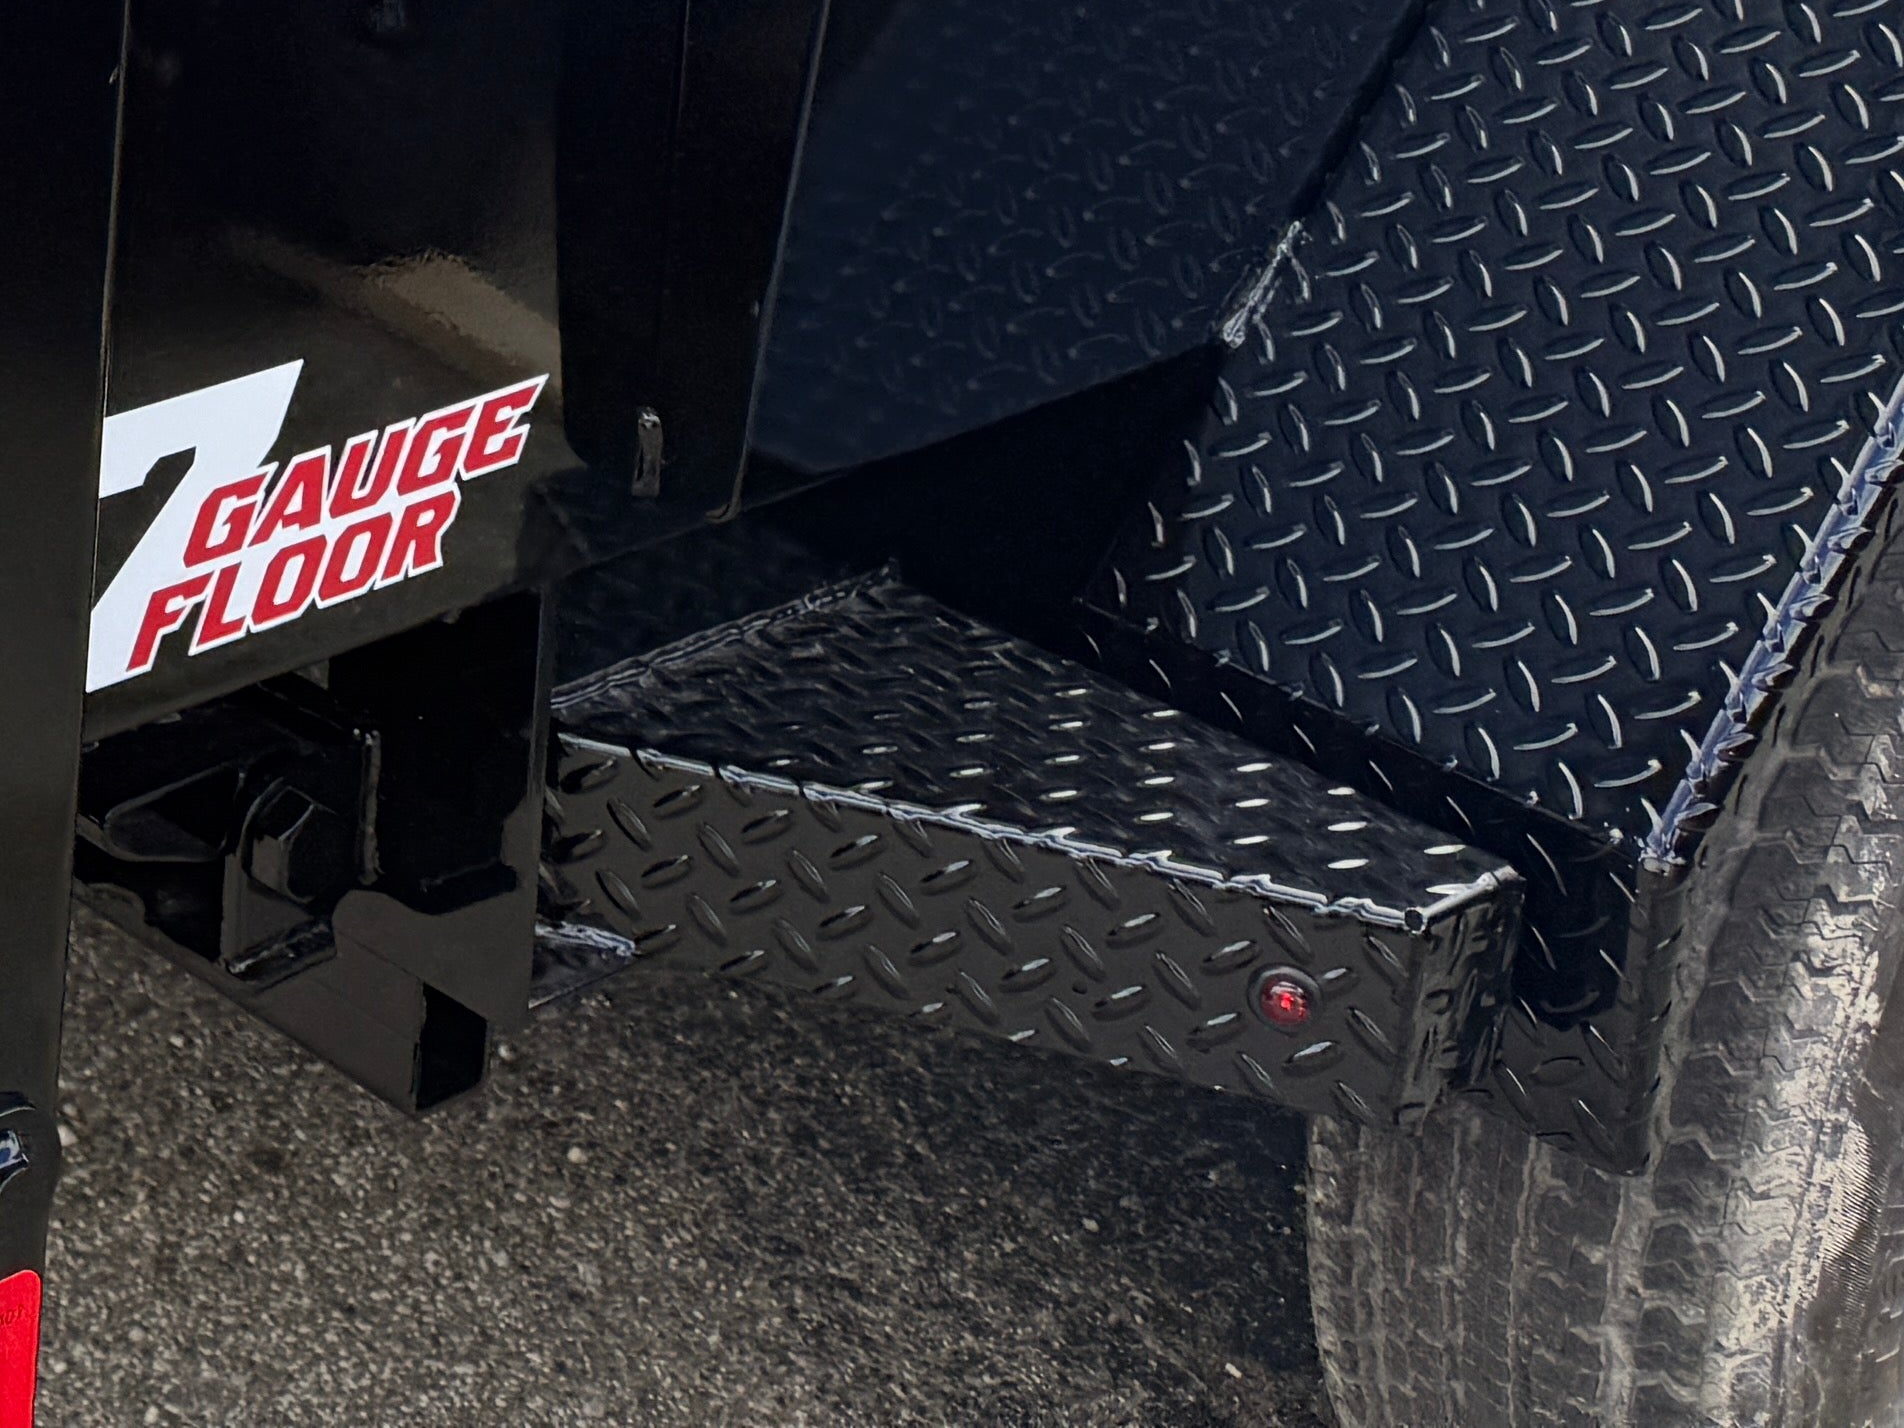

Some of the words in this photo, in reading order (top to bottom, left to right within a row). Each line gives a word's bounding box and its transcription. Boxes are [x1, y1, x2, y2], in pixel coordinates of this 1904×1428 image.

[86, 358, 305, 694] 7
[181, 372, 550, 569] GAUGE
[125, 481, 462, 672] FLOOR
